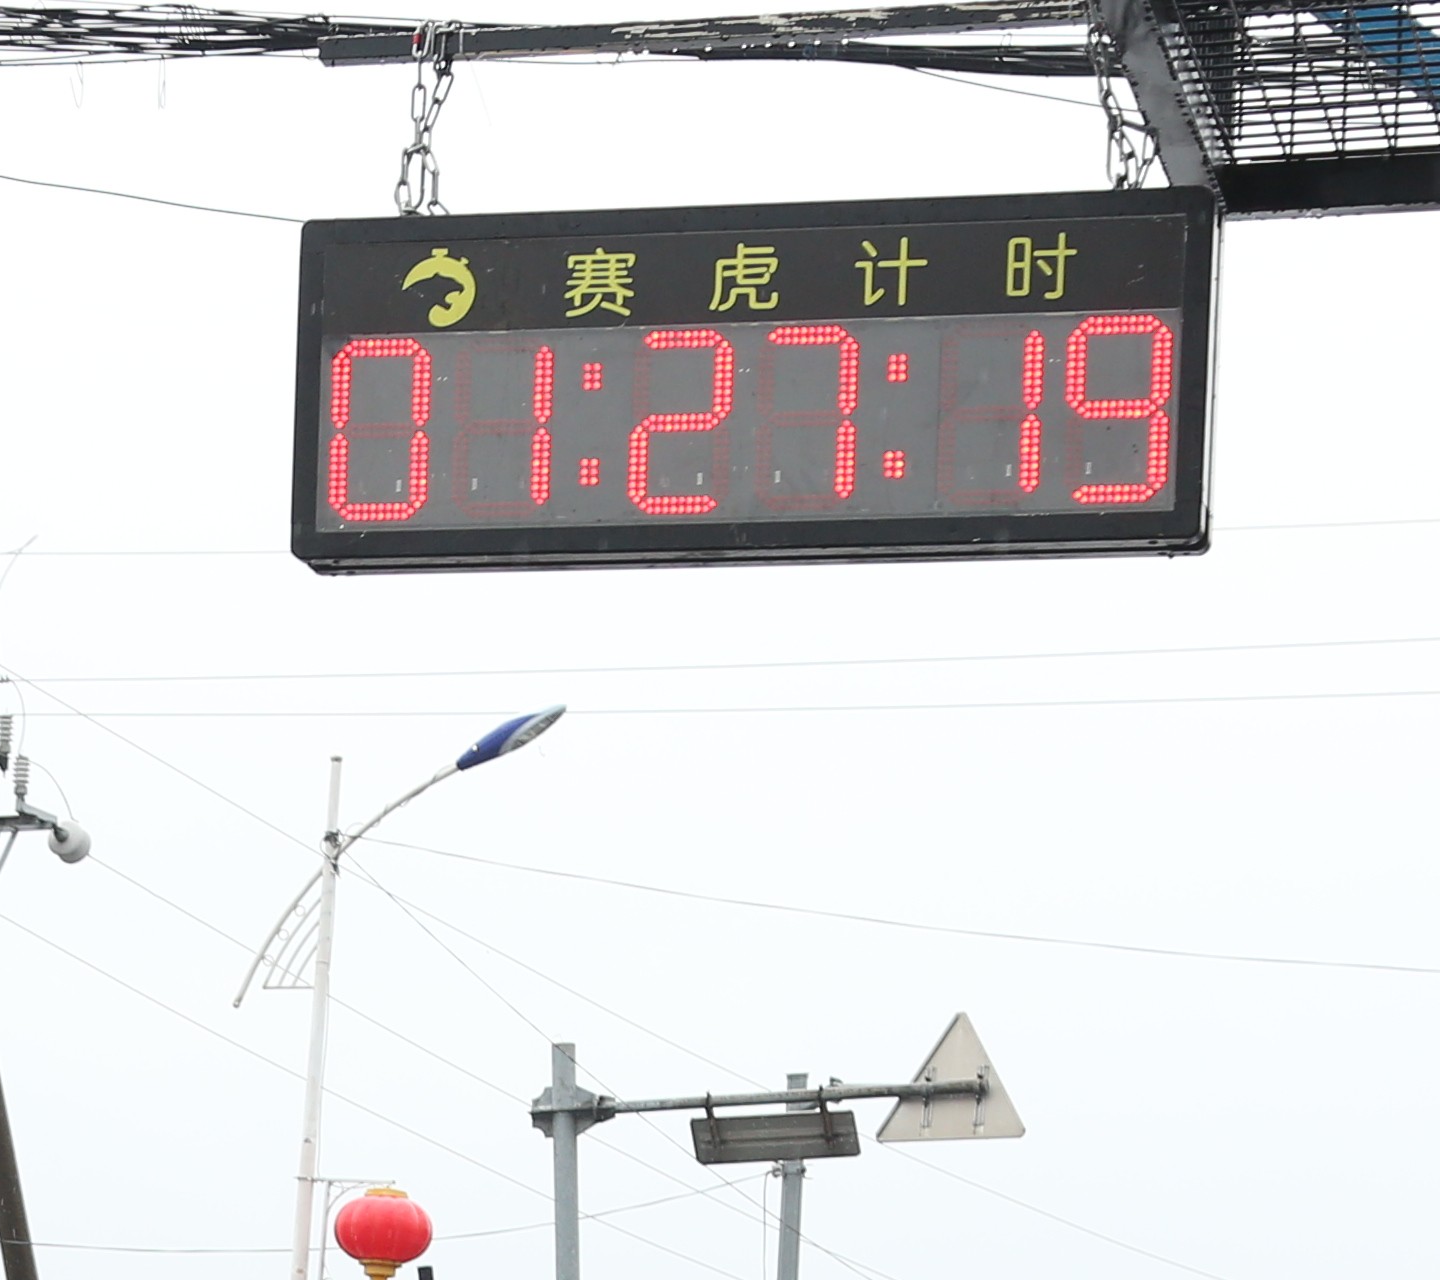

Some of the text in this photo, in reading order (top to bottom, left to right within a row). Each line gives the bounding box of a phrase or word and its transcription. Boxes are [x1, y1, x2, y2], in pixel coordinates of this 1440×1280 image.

[564, 231, 1078, 319] 赛虎计时
[328, 313, 1173, 522] 01:27:19
